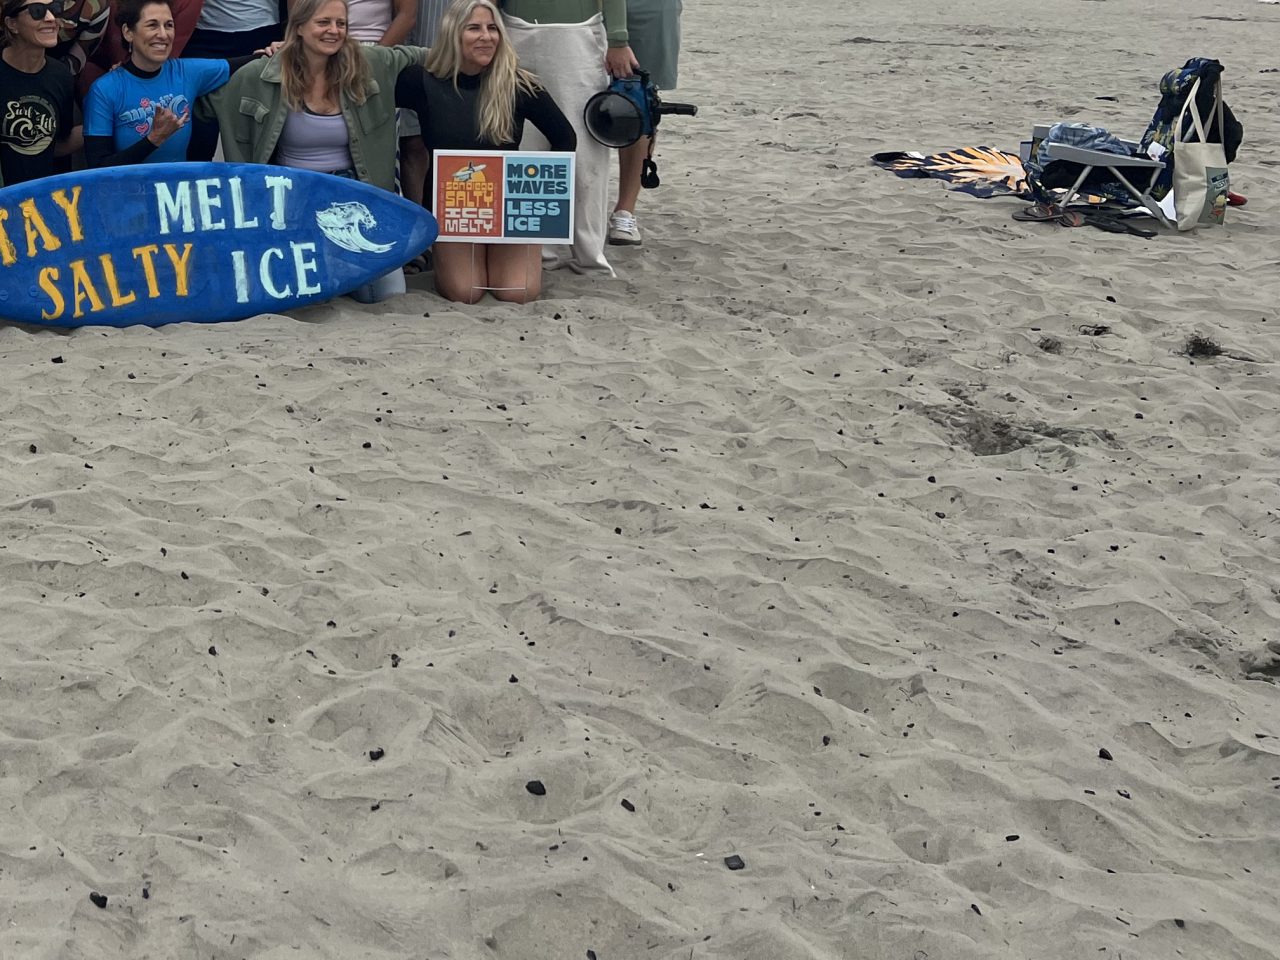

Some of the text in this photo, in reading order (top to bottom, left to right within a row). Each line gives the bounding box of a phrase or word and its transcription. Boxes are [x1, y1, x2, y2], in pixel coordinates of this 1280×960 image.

[5, 101, 33, 120] Surf
[507, 163, 567, 179] MORE
[507, 180, 568, 195] WAVES
[154, 175, 293, 235] MELT
[445, 190, 494, 208] SALTY
[506, 200, 561, 216] LESS
[445, 218, 494, 233] MELTY
[507, 216, 540, 232] ICE
[231, 240, 322, 303] ICE
[38, 243, 193, 320] SALTY
